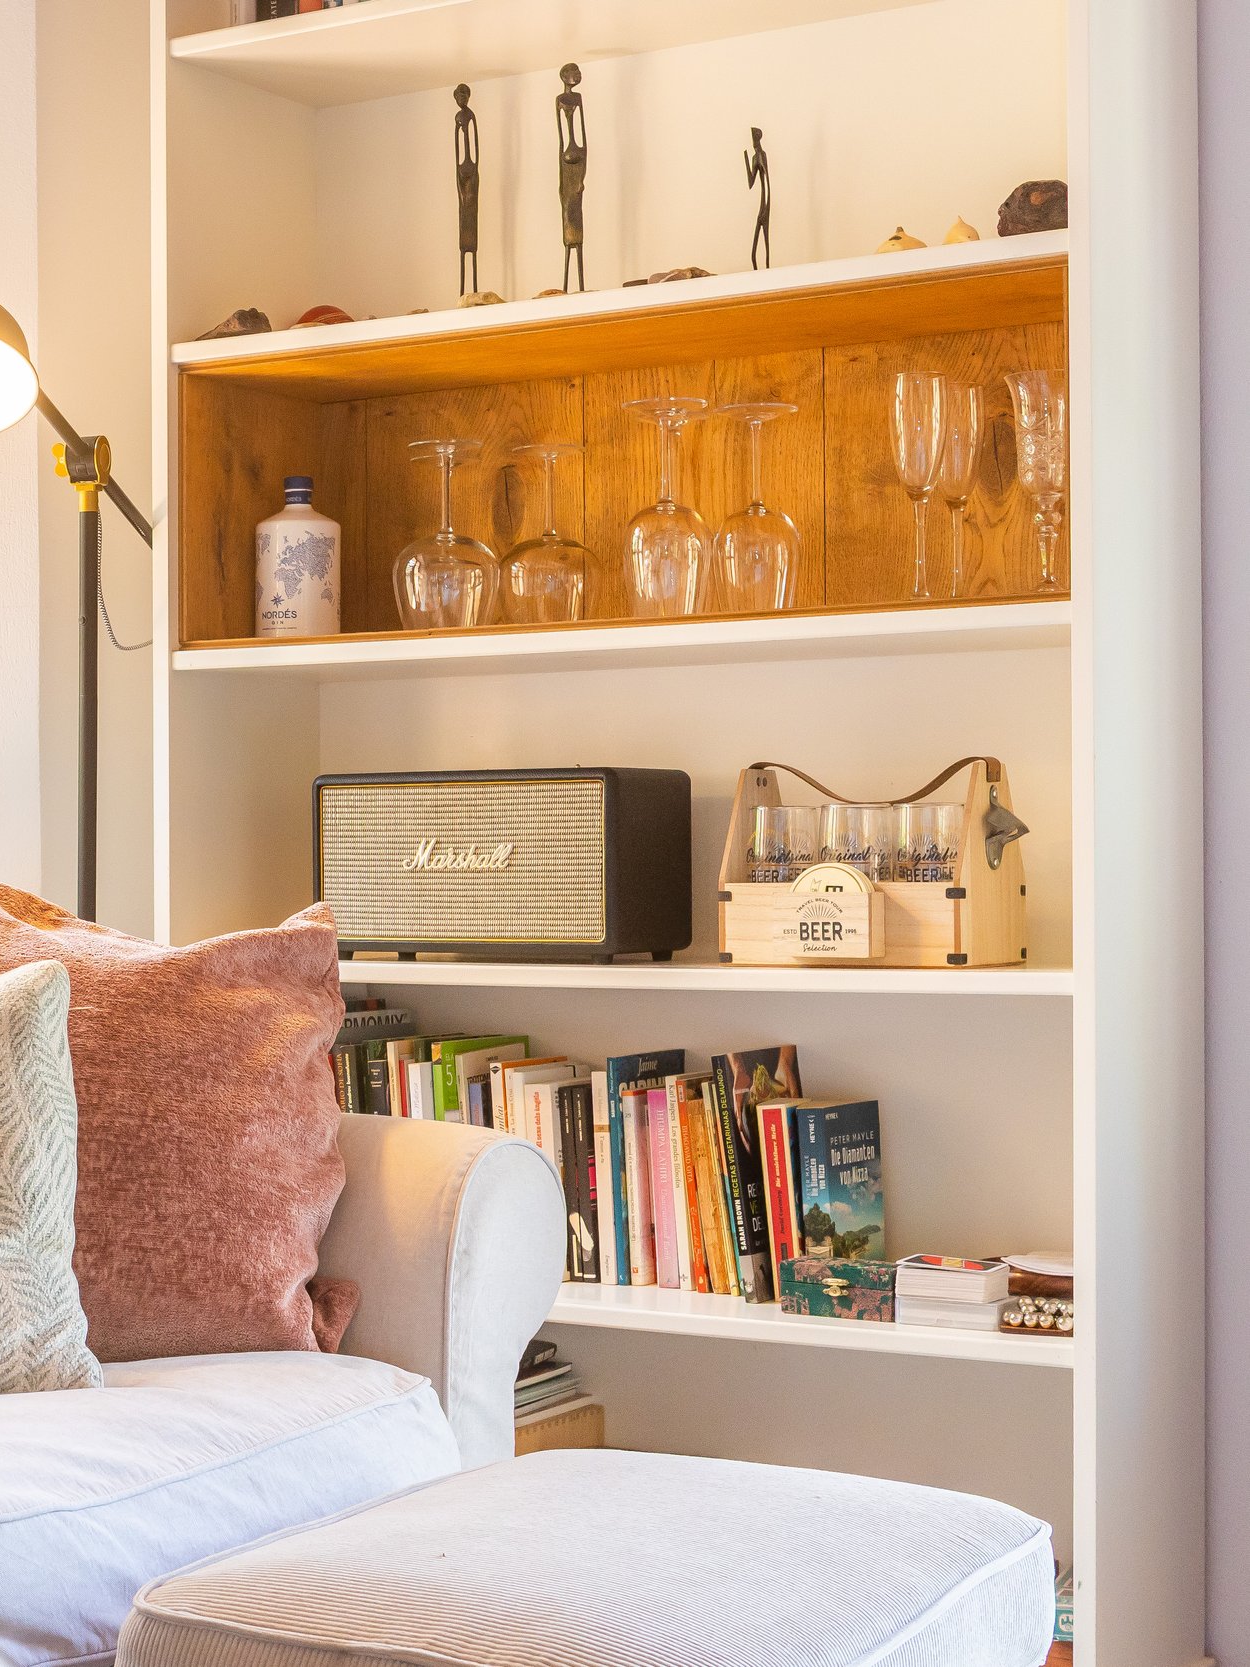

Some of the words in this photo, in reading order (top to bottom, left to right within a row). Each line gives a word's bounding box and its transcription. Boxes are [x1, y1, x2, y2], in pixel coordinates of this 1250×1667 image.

[262, 608, 297, 620] NORDÉS
[403, 838, 514, 870] Marshall
[751, 869, 780, 883] BEER
[906, 868, 939, 883] BEER
[799, 921, 843, 941] BEER
[803, 943, 838, 952] Selection
[637, 1057, 658, 1076] Jaime
[722, 1110, 735, 1163] VEGETARIANAS
[830, 1134, 851, 1145] PETER
[852, 1130, 874, 1142] MAYLE
[831, 1147, 841, 1166] Die
[842, 1143, 875, 1164] Diamanten
[658, 1148, 667, 1182] LAHIRI
[730, 1165, 741, 1198] RECETAS
[839, 1170, 852, 1185] von
[852, 1166, 869, 1184] Nizza
[734, 1198, 744, 1225] BROWN
[738, 1226, 747, 1251] SARAH
